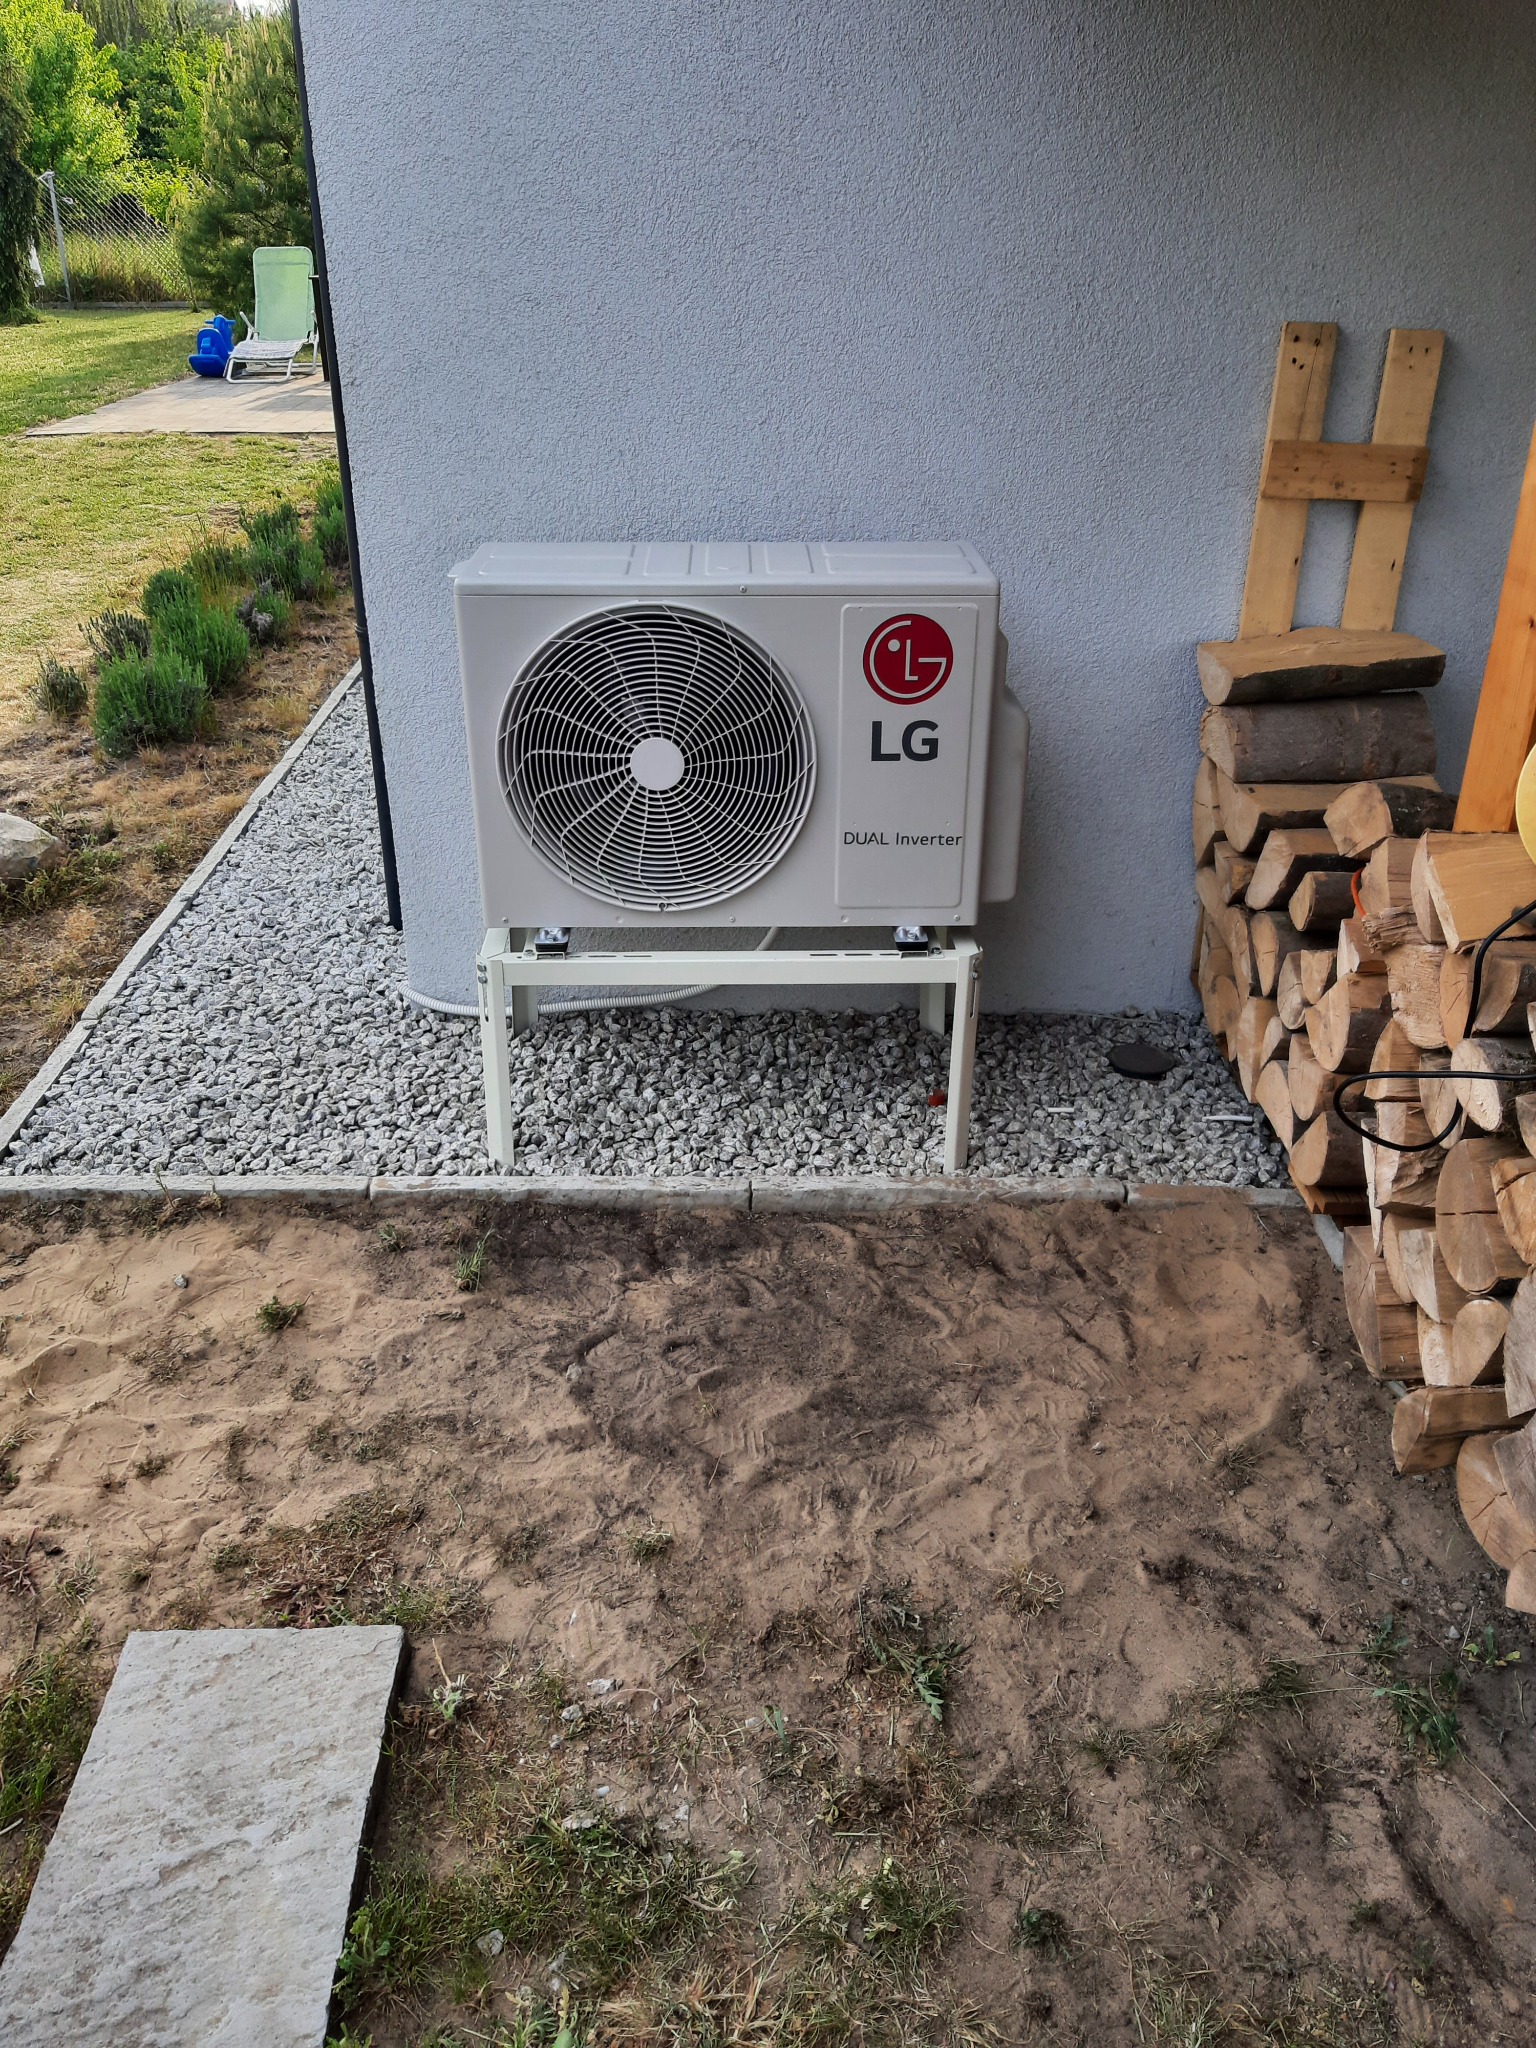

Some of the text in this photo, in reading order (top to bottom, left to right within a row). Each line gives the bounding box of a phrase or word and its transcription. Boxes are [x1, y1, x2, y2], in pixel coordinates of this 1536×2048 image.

[870, 720, 939, 762] LG
[843, 831, 963, 847] DUAL Inverter
